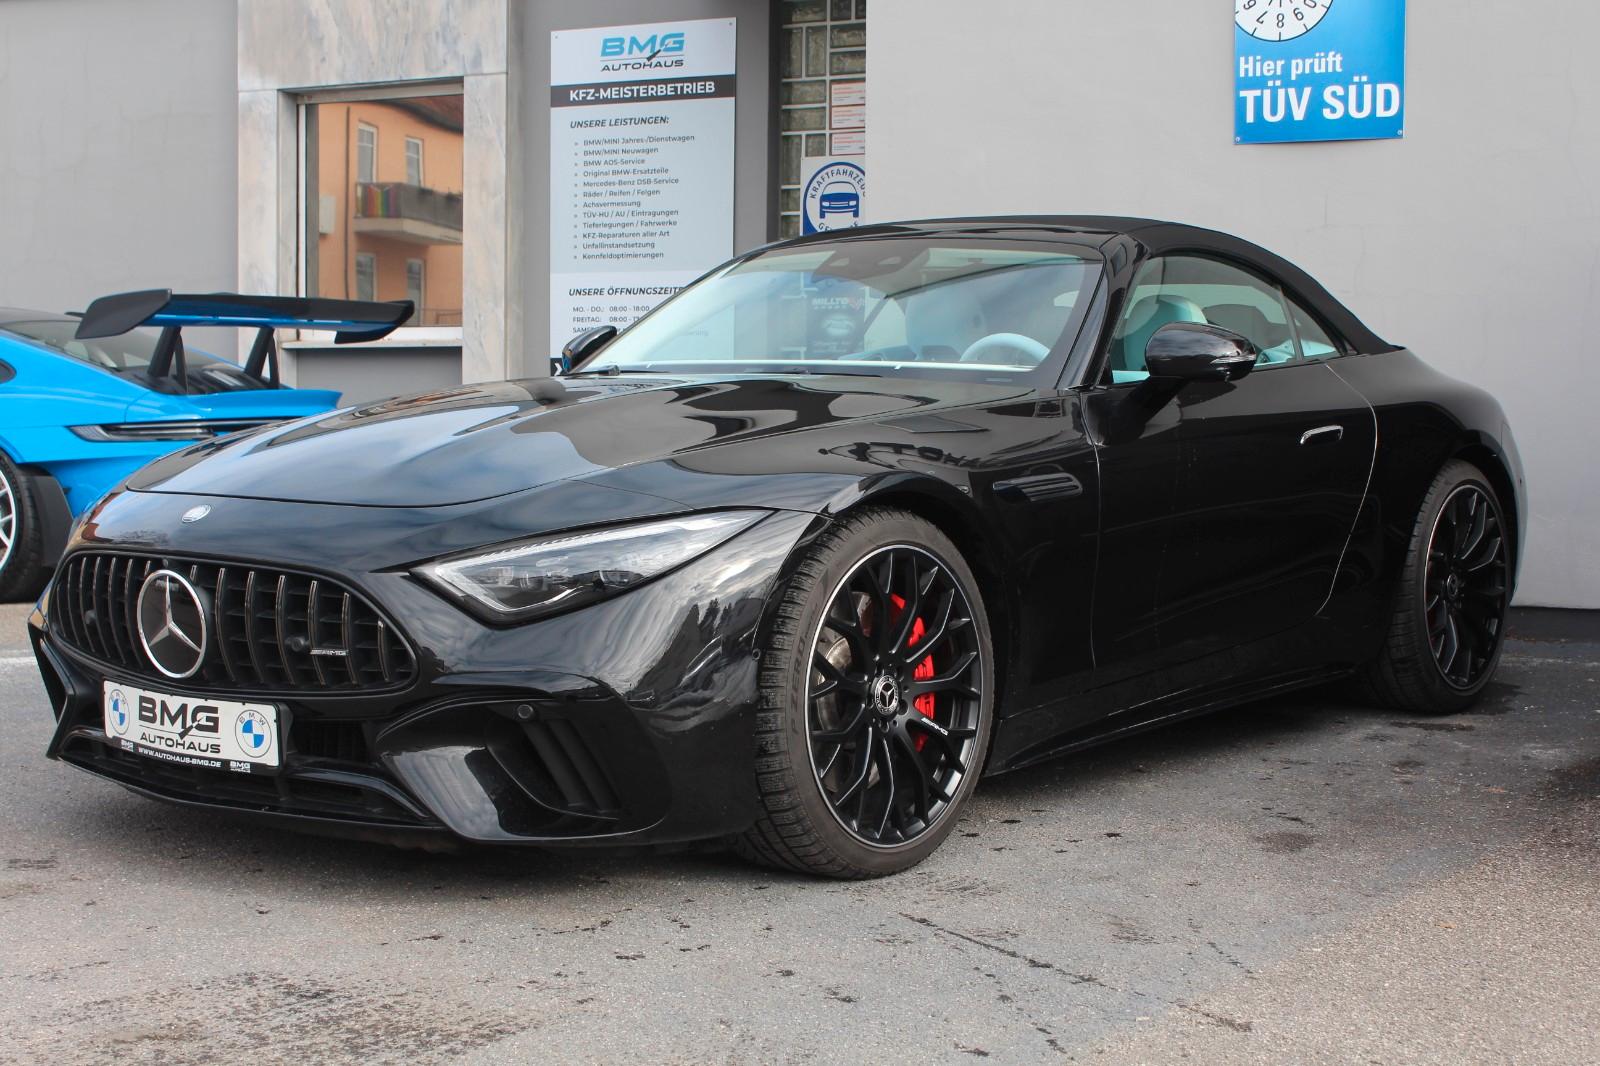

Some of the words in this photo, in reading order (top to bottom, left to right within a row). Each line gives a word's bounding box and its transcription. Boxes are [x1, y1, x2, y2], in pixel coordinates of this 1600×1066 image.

[1276, 13, 1285, 28] 8
[601, 32, 684, 57] BMG
[601, 59, 684, 72] AUTOHAUS
[1239, 55, 1285, 77] Hier
[1291, 51, 1343, 80] prüft
[570, 81, 715, 101] KFZ-MEISTERBETRIEB
[1239, 80, 1312, 123] TÜV
[1322, 76, 1400, 120] SÜD
[570, 119, 606, 129] UNSERE
[609, 116, 669, 127] LEISTUNGEN:
[583, 138, 620, 146] BMW/MINI
[621, 135, 695, 144] Jahres-/Dienstwagen
[583, 149, 620, 157] BMW/MINI
[621, 147, 659, 156] Neuwagen
[583, 170, 610, 178] Original
[611, 168, 669, 176] BMW-Ersatzteile
[637, 189, 661, 197] Felgen
[583, 200, 641, 208] Achsvermessung
[631, 209, 679, 218] Eintragungen
[583, 221, 635, 230] Tieferlegungen
[583, 231, 641, 239] KFZ-Reparaturen
[642, 230, 658, 238] aller
[583, 241, 655, 249] Unfallinstandsetzung
[583, 251, 664, 260] Kennfeldoptimierungen
[568, 287, 605, 296] UNSERE
[139, 695, 219, 733] BMG
[140, 731, 221, 754] AUTOHAUS
[138, 747, 222, 768] WWW.AUTOHAUS-BMG.DE
